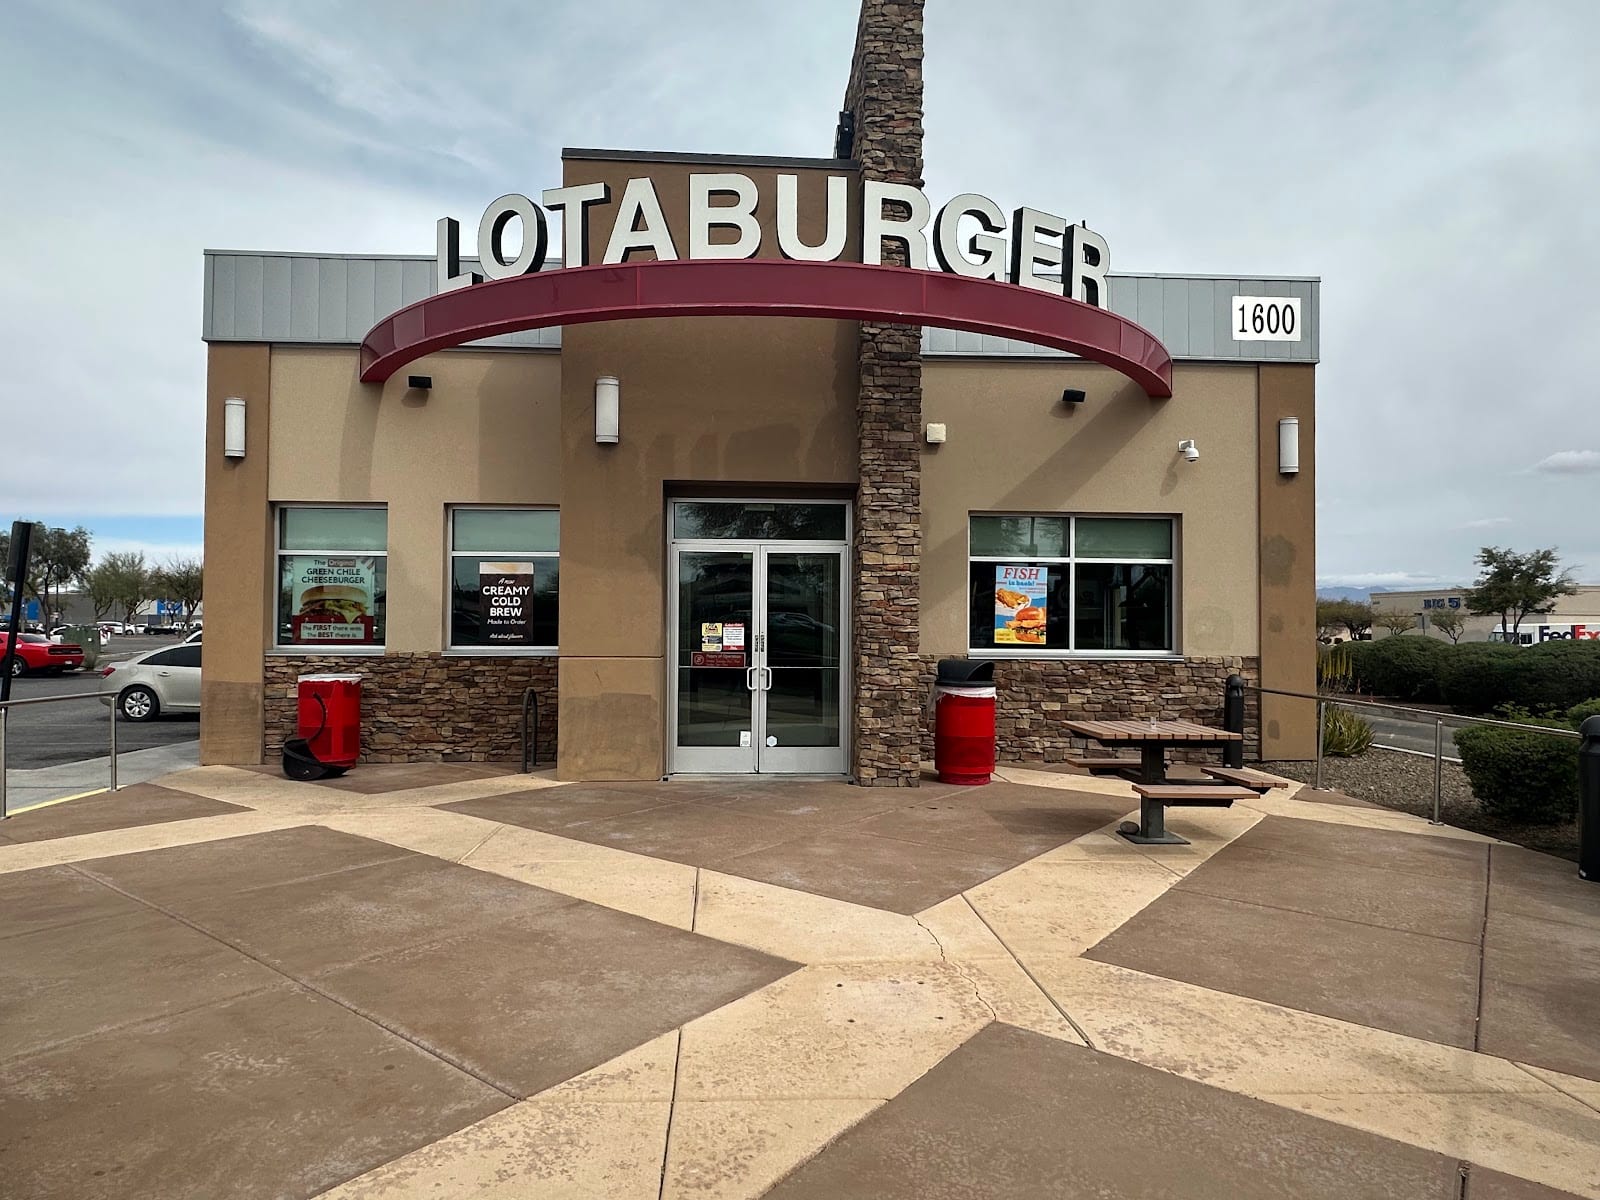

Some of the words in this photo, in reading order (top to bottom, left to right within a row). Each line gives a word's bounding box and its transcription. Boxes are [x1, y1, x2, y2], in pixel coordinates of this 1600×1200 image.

[436, 172, 1112, 311] LOTABURGER
[1238, 303, 1295, 335] 1600
[1003, 567, 1040, 580] FISH
[301, 576, 365, 584] CHEESEBURGER
[482, 586, 530, 595] CREAMY
[491, 596, 521, 606] COLD
[1447, 597, 1461, 609] 5
[489, 607, 523, 617] BREW
[1539, 624, 1600, 642] FedEx
